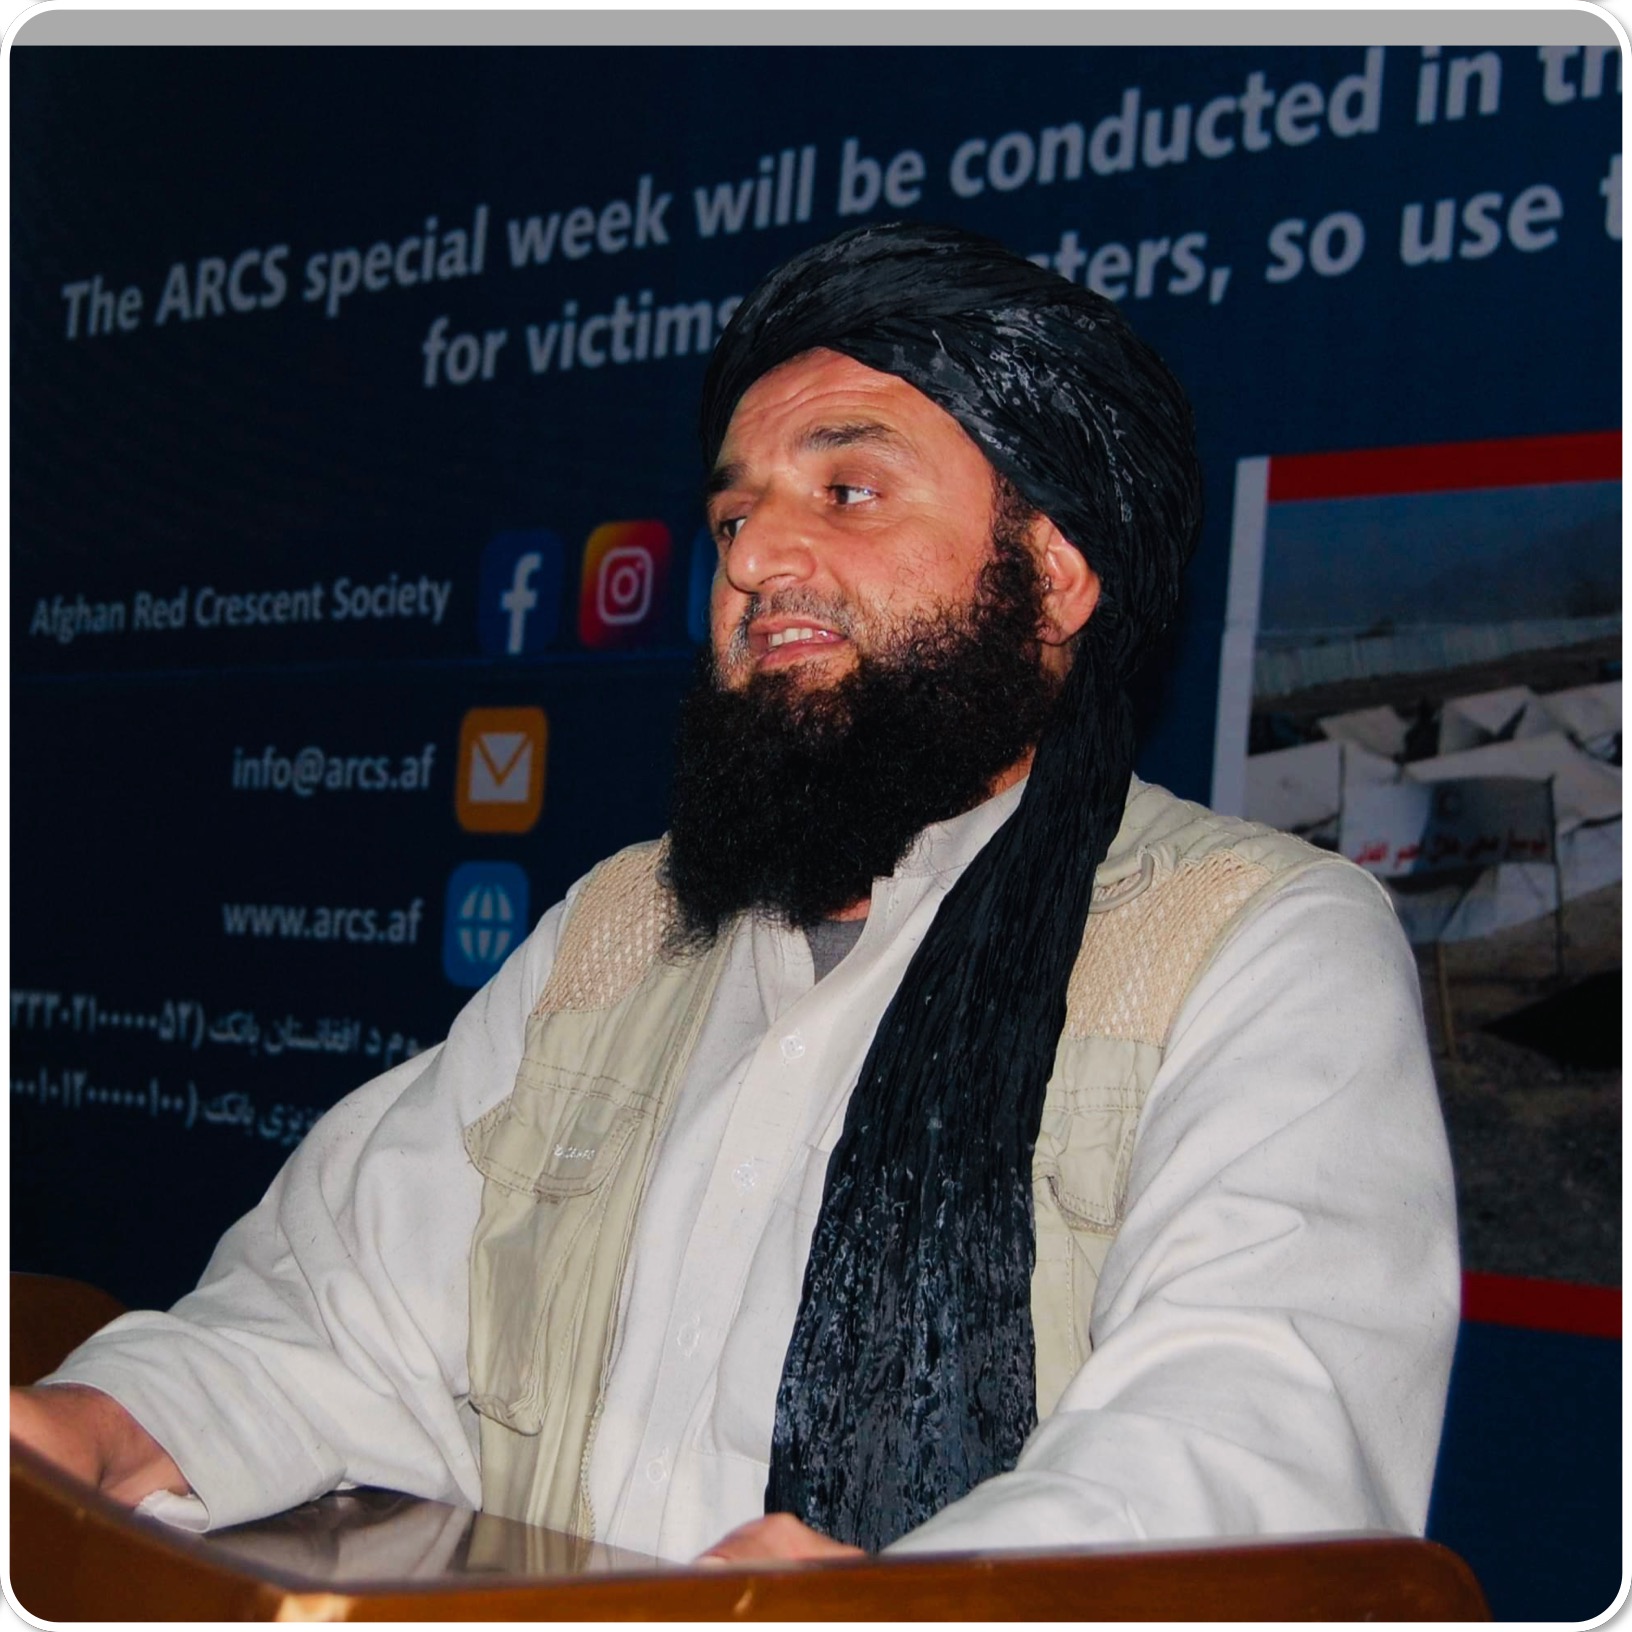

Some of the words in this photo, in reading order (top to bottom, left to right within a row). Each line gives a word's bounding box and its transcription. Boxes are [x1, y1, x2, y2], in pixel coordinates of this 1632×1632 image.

[62, 275, 142, 338] The
[156, 245, 288, 325] ARCS
[304, 204, 488, 317] special
[508, 174, 672, 266] week
[694, 146, 816, 237] will
[838, 138, 925, 215] be
[948, 47, 1384, 197] conducted
[1417, 47, 1502, 124] in
[423, 317, 507, 387] for
[1266, 211, 1365, 282] so
[1401, 184, 1563, 265] use
[30, 594, 125, 643] Afghan
[134, 588, 188, 629] Red
[194, 583, 324, 627] Crescent
[332, 574, 451, 624] Society
[233, 743, 436, 797] info@arcs.af
[224, 898, 423, 943] www.arcs.af
[264, 1017, 360, 1054] افغانستان
